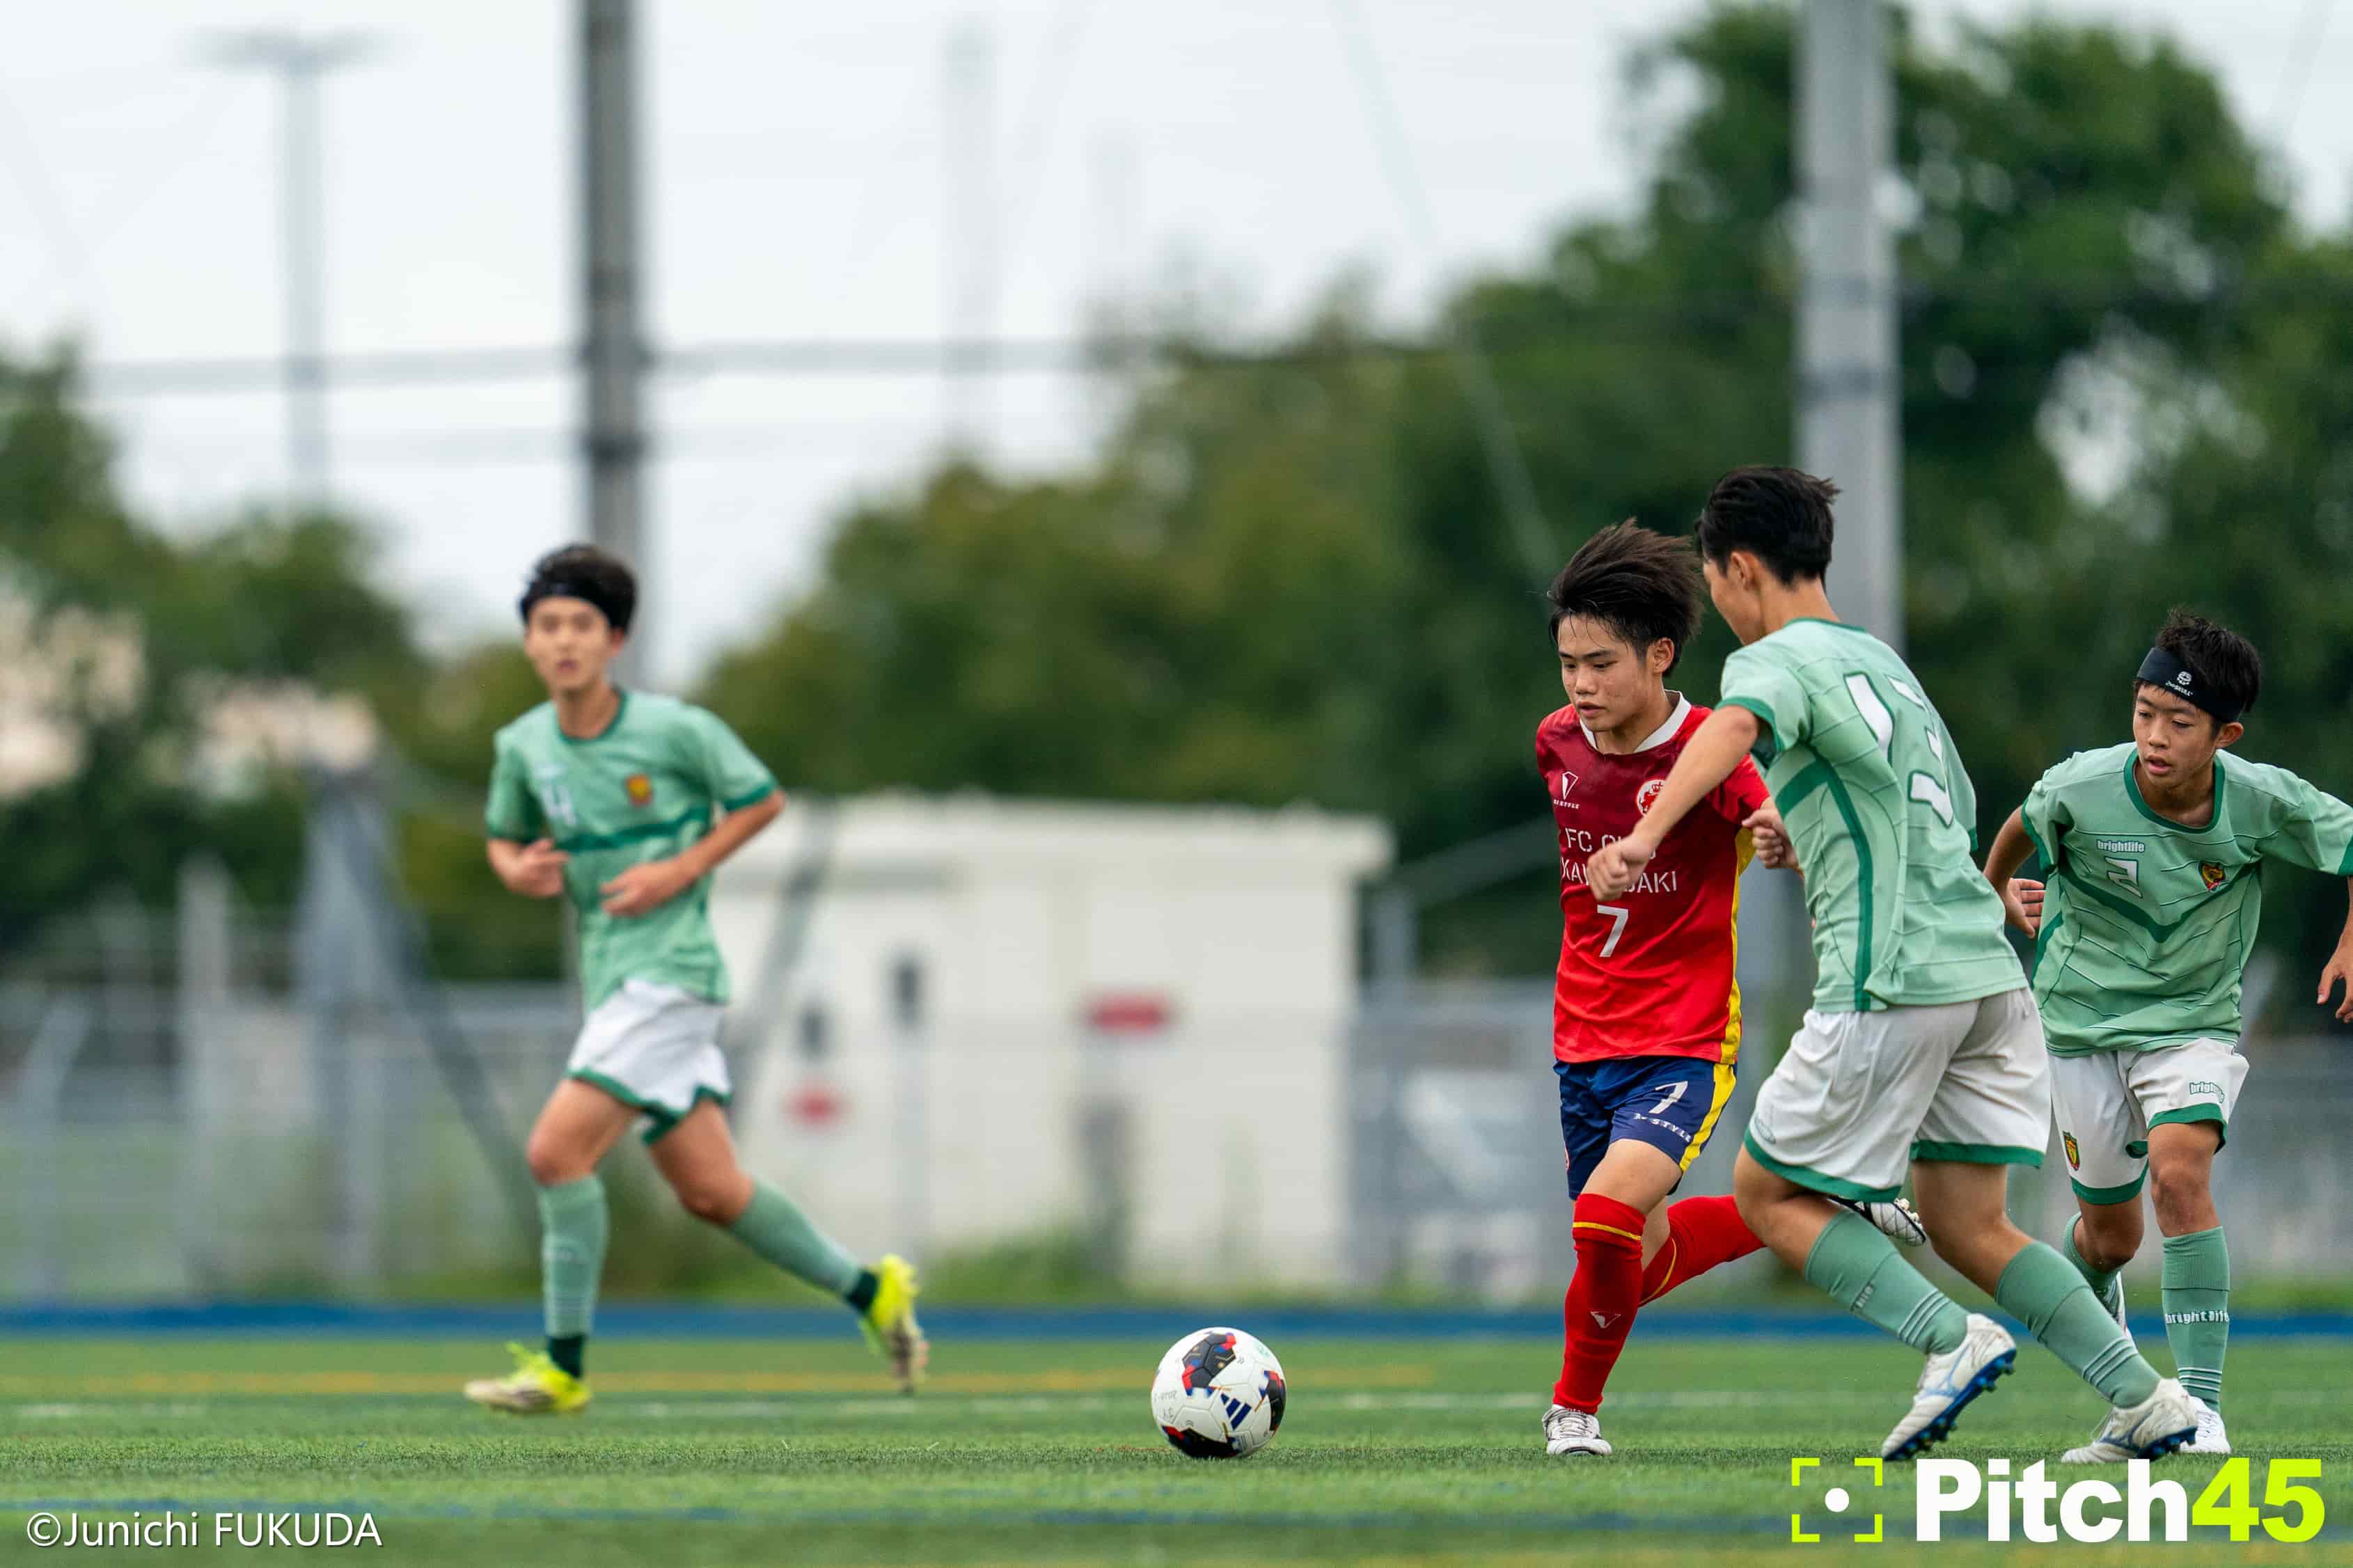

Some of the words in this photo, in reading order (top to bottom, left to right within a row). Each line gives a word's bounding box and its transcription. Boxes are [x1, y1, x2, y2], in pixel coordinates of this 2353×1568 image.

[1843, 672, 1954, 830] 13
[1565, 827, 1593, 853] FC
[2096, 839, 2145, 853] brightlife
[1561, 857, 1677, 894] KAAKI
[2104, 856, 2143, 899] 3
[1597, 904, 1629, 958] 7
[1648, 1080, 1688, 1114] 7
